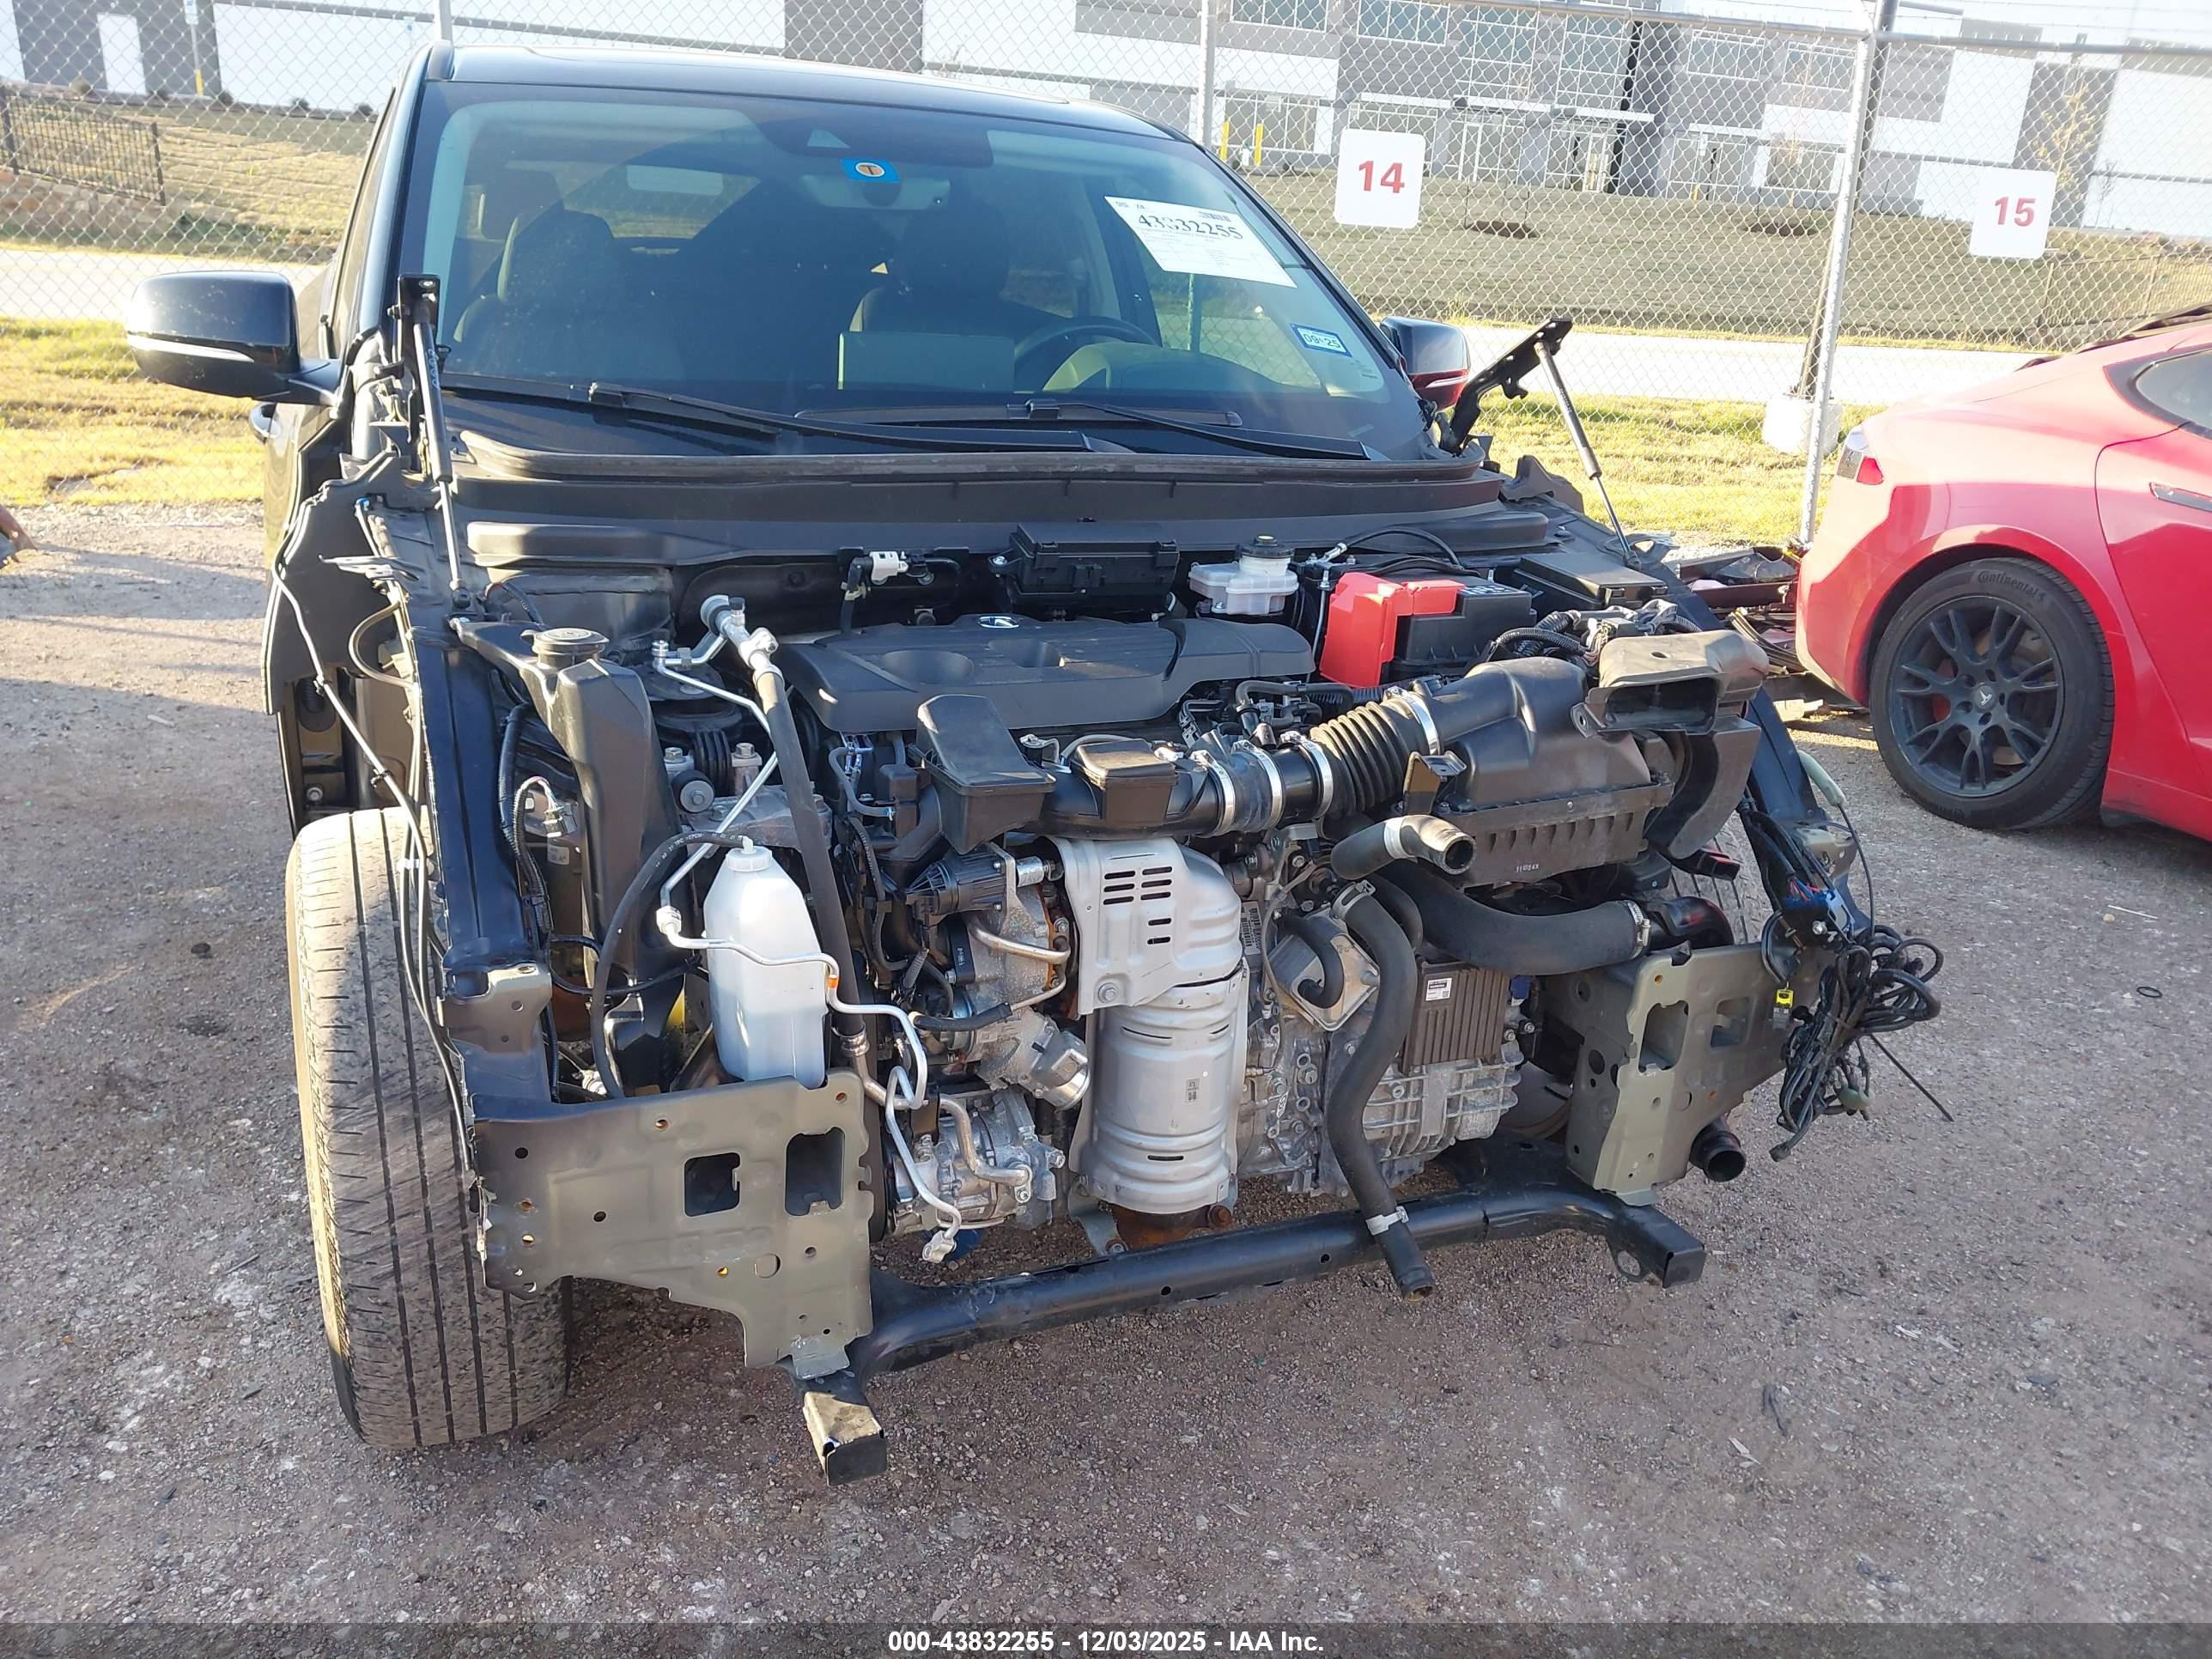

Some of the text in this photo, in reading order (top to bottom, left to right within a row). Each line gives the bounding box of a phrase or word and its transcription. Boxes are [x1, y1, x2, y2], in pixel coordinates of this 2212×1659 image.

[1358, 160, 1405, 194] 14
[1994, 196, 2036, 228] 15
[1324, 337, 1340, 349] 25
[1978, 570, 2039, 597] Continental
